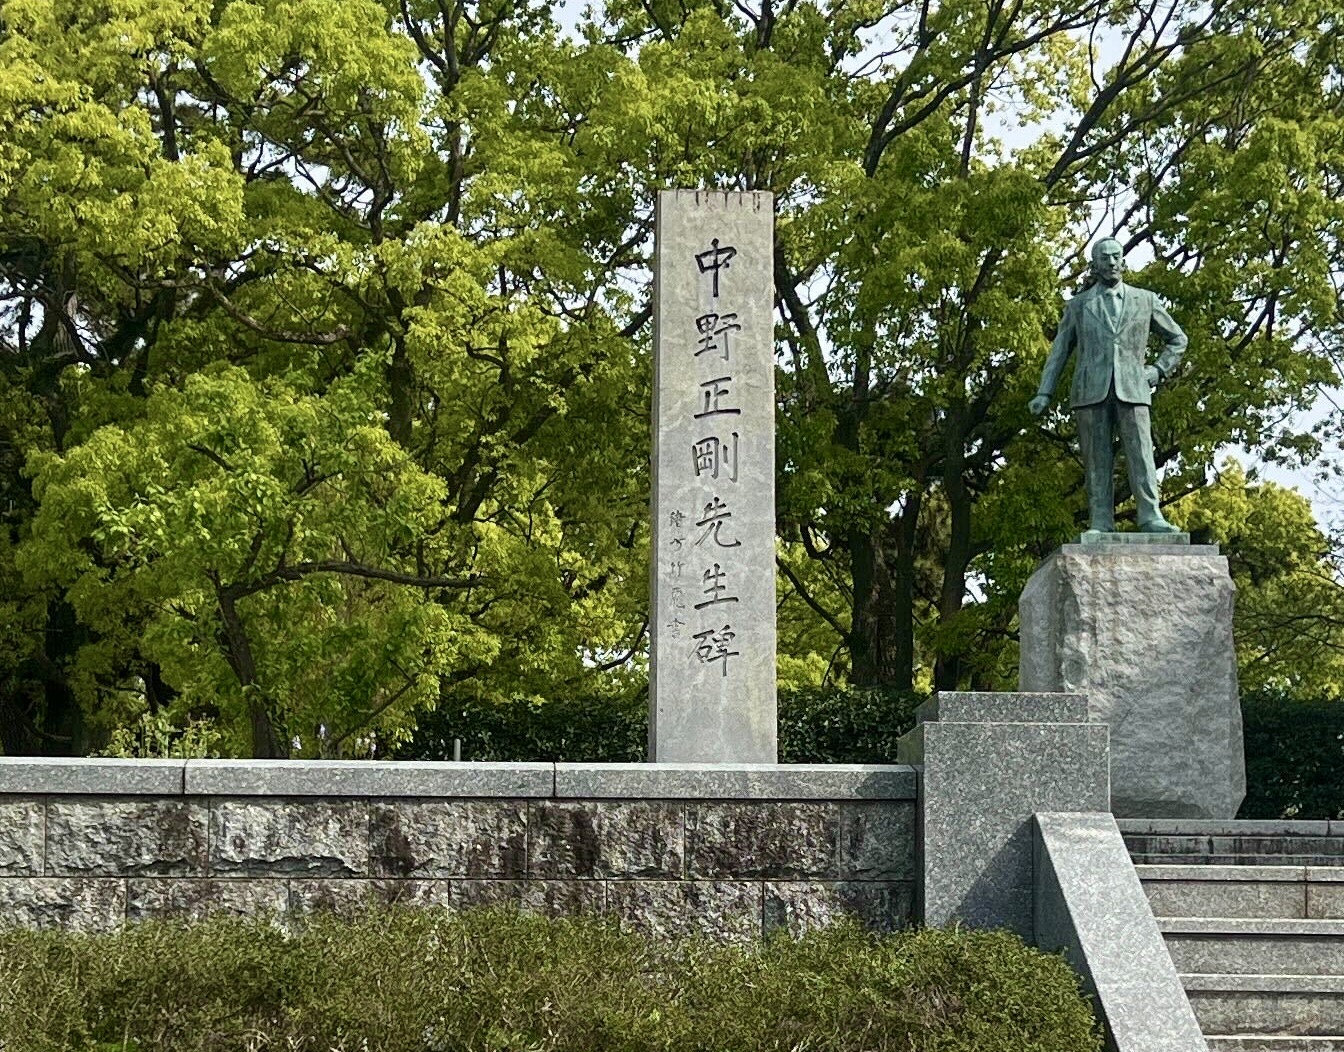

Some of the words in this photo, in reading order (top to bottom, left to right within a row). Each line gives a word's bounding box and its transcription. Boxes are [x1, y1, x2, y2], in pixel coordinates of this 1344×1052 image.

[687, 237, 742, 677] 中野正剛先生碑
